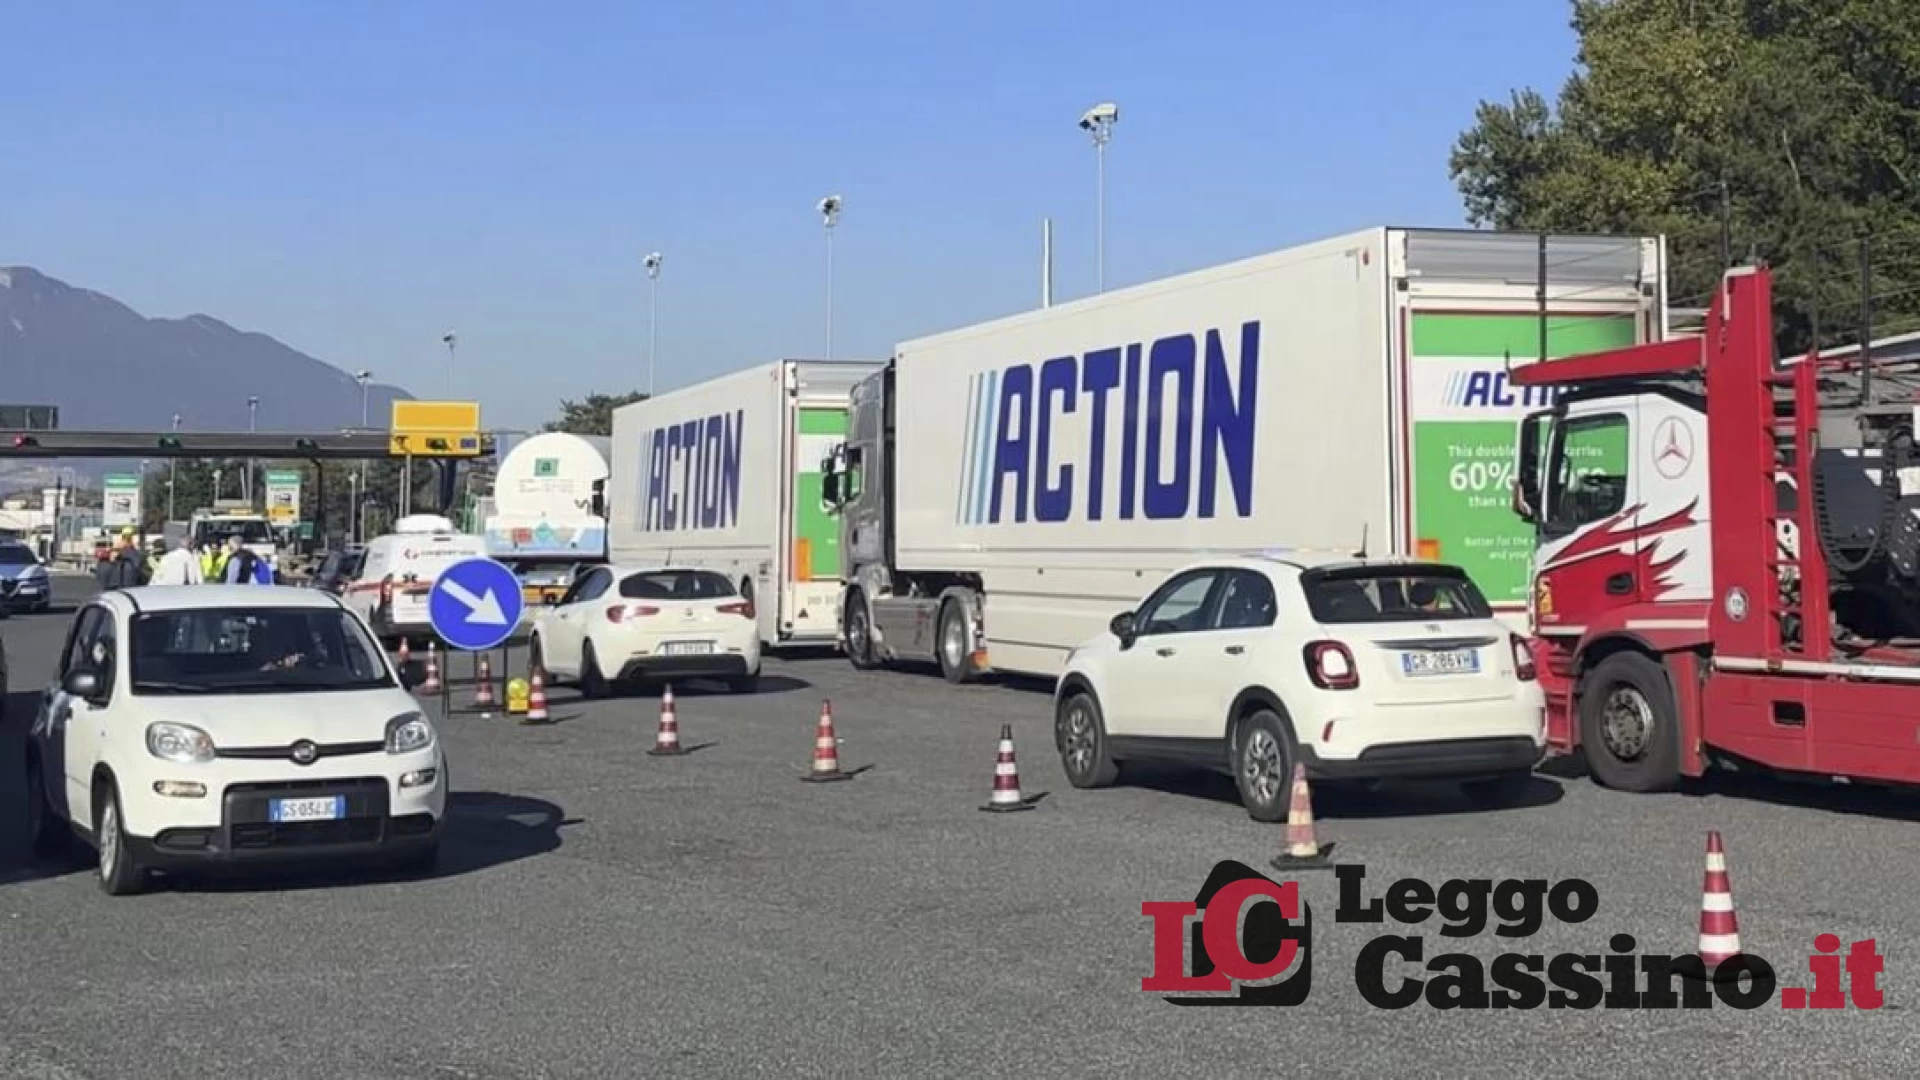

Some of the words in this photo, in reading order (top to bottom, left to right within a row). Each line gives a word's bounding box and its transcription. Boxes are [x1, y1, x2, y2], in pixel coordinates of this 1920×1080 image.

[988, 320, 1260, 524] ACTION
[1448, 445, 1472, 457] This
[646, 409, 744, 532] ACTION
[1450, 461, 1519, 491] 60%
[1469, 496, 1497, 508] than
